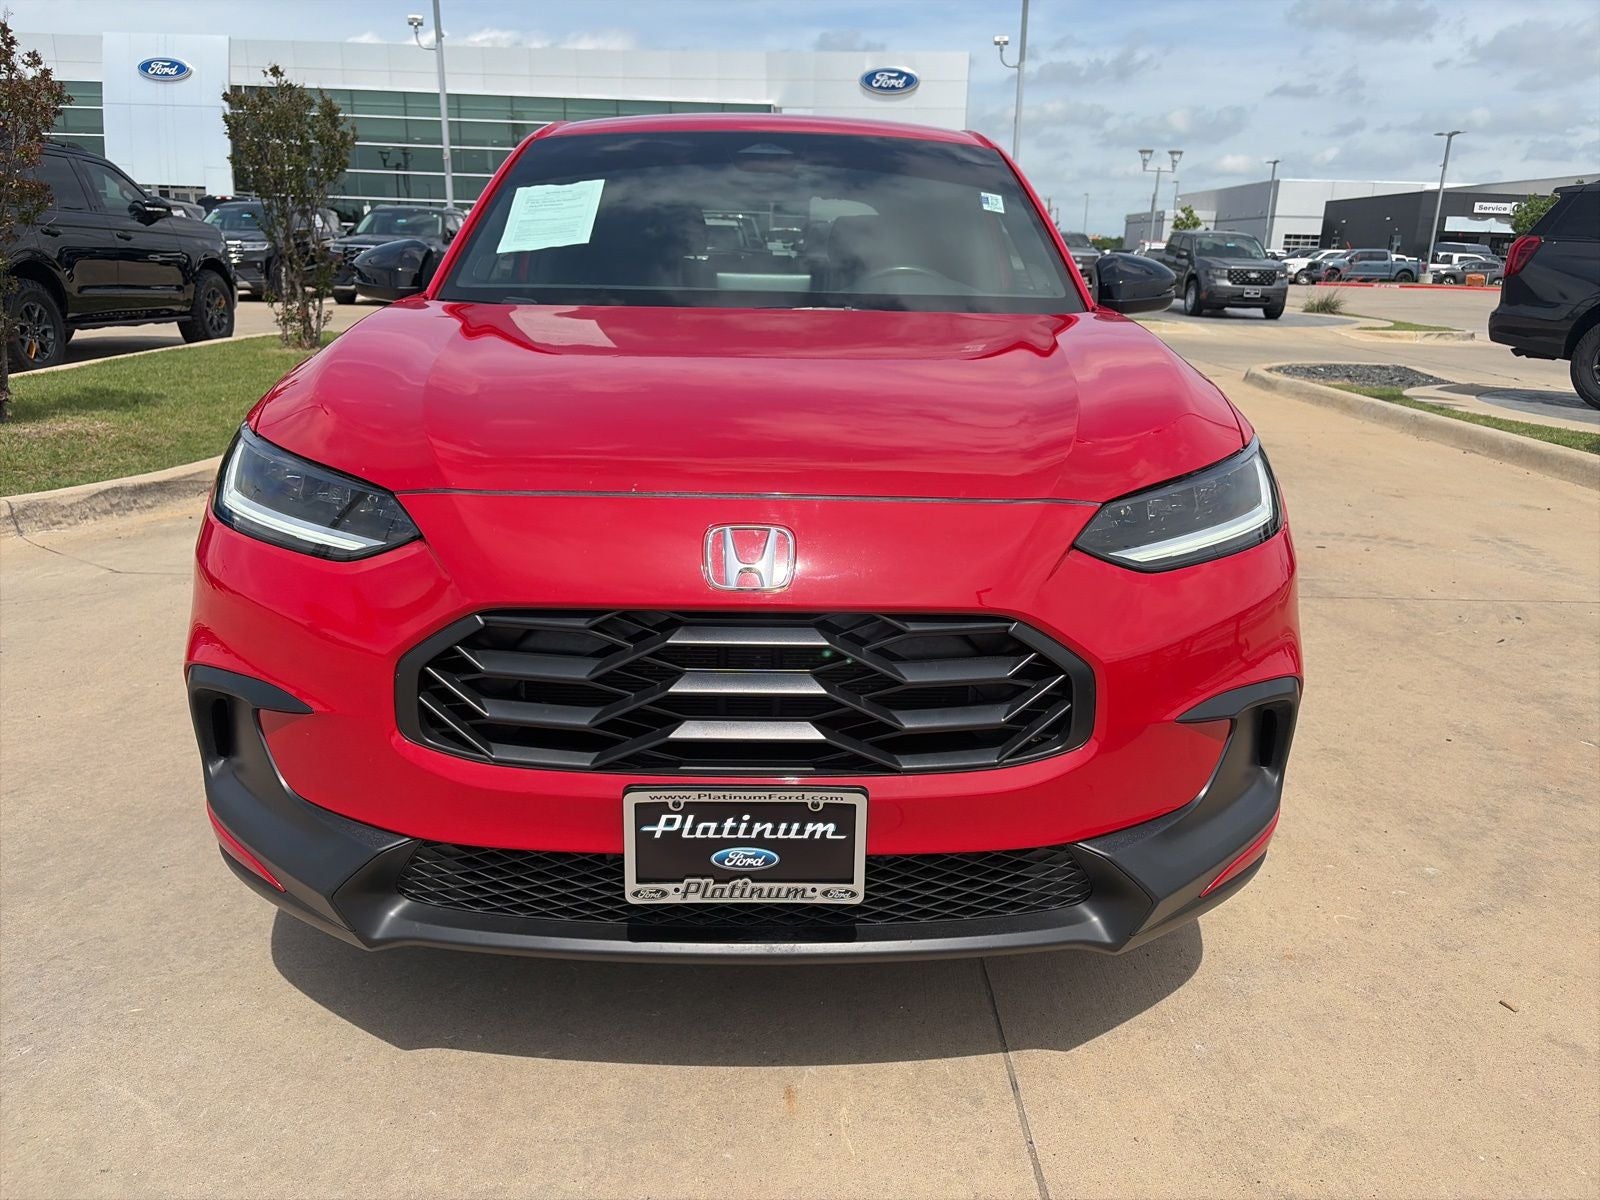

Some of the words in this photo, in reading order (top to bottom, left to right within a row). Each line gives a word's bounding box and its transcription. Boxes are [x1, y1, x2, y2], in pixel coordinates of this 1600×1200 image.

[147, 61, 179, 75] Ford
[871, 72, 908, 88] Ford
[1478, 204, 1508, 212] Service
[648, 793, 845, 802] www.PlatinumFord.com
[640, 814, 848, 840] Platinum
[724, 850, 767, 867] Ford
[638, 889, 662, 900] Ford
[675, 881, 816, 901] Platinum
[827, 889, 852, 900] Ford
